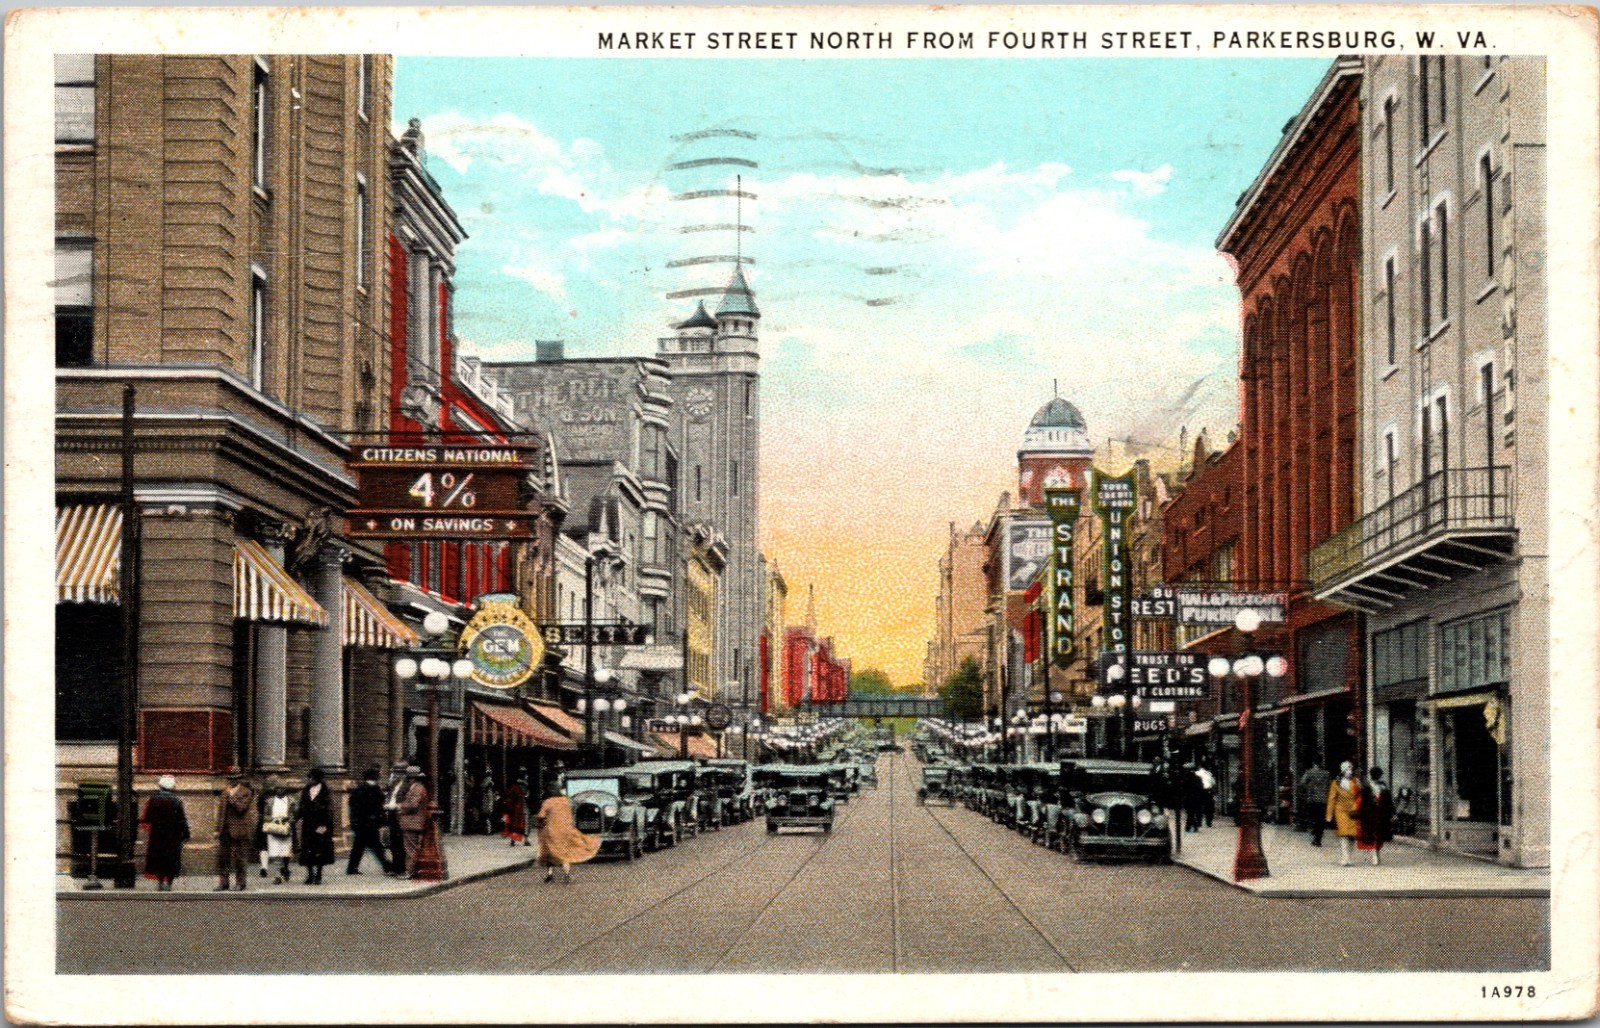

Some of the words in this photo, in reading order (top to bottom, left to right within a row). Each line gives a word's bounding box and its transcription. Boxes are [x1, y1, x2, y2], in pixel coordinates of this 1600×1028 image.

[362, 448, 437, 461] CITIZENS
[444, 450, 521, 463] NATIONAL
[409, 472, 475, 508] 4%
[1052, 497, 1076, 506] THE
[391, 518, 415, 531] ON
[422, 518, 494, 531] SAVINGS
[1110, 511, 1122, 587] UNION
[1057, 523, 1073, 655] STRAND
[483, 639, 519, 653] GEM
[1136, 655, 1169, 664] TRUST
